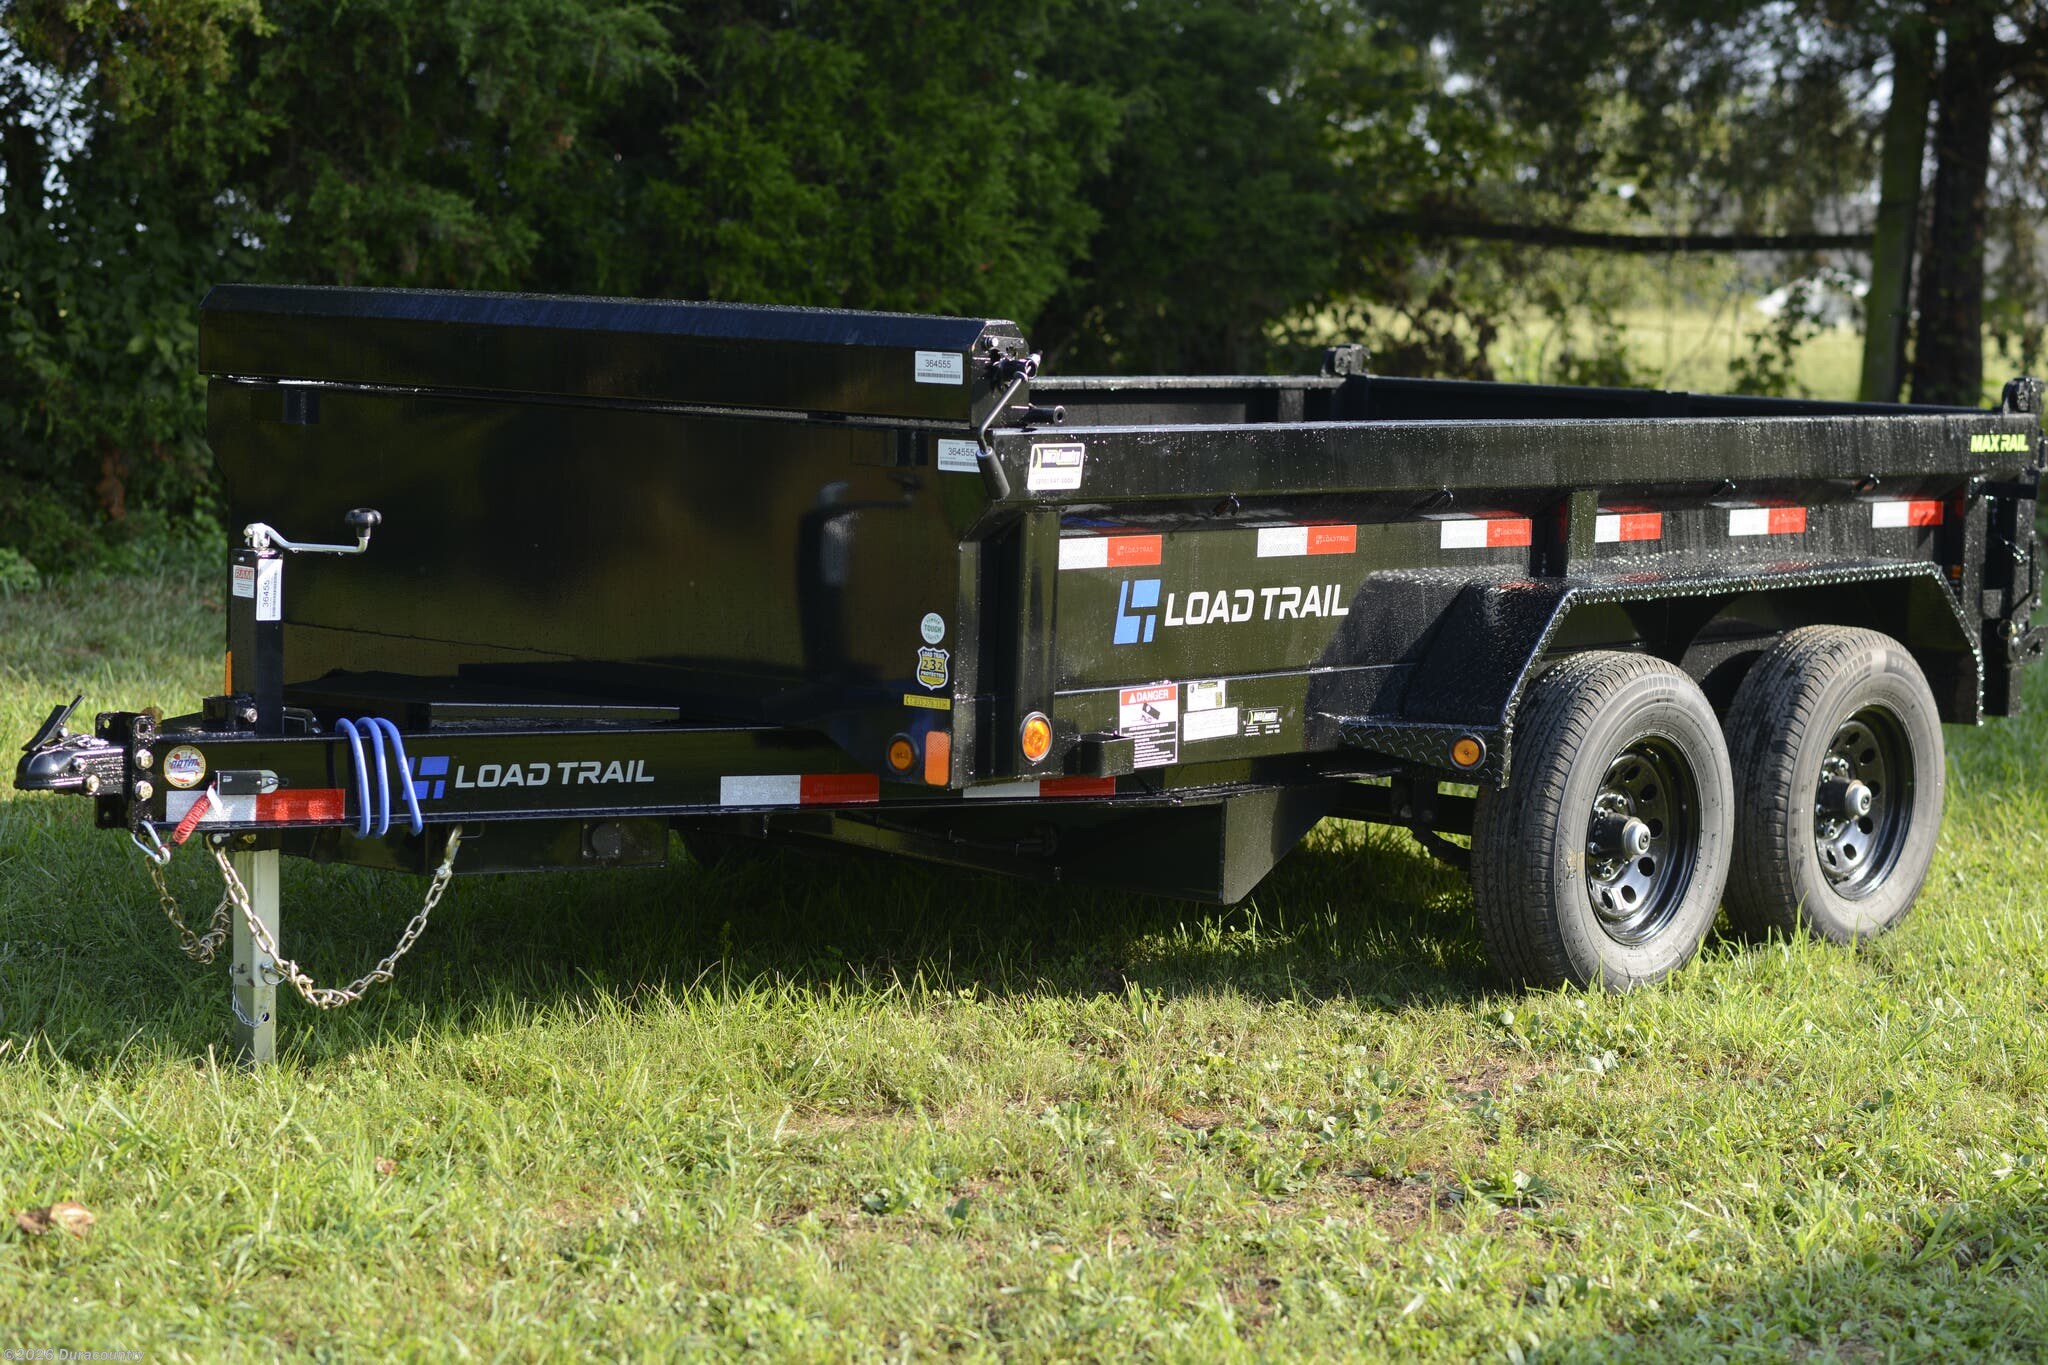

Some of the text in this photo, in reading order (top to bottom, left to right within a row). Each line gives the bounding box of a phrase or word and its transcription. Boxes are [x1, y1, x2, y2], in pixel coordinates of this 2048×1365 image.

[925, 359, 952, 369] 364555
[1970, 433, 2029, 452] MAX RAIL
[1164, 584, 1349, 626] LOAD TRAIL
[923, 659, 943, 671] 232
[1136, 689, 1169, 702] DANGER
[455, 759, 654, 788] LOAD TRAIL
